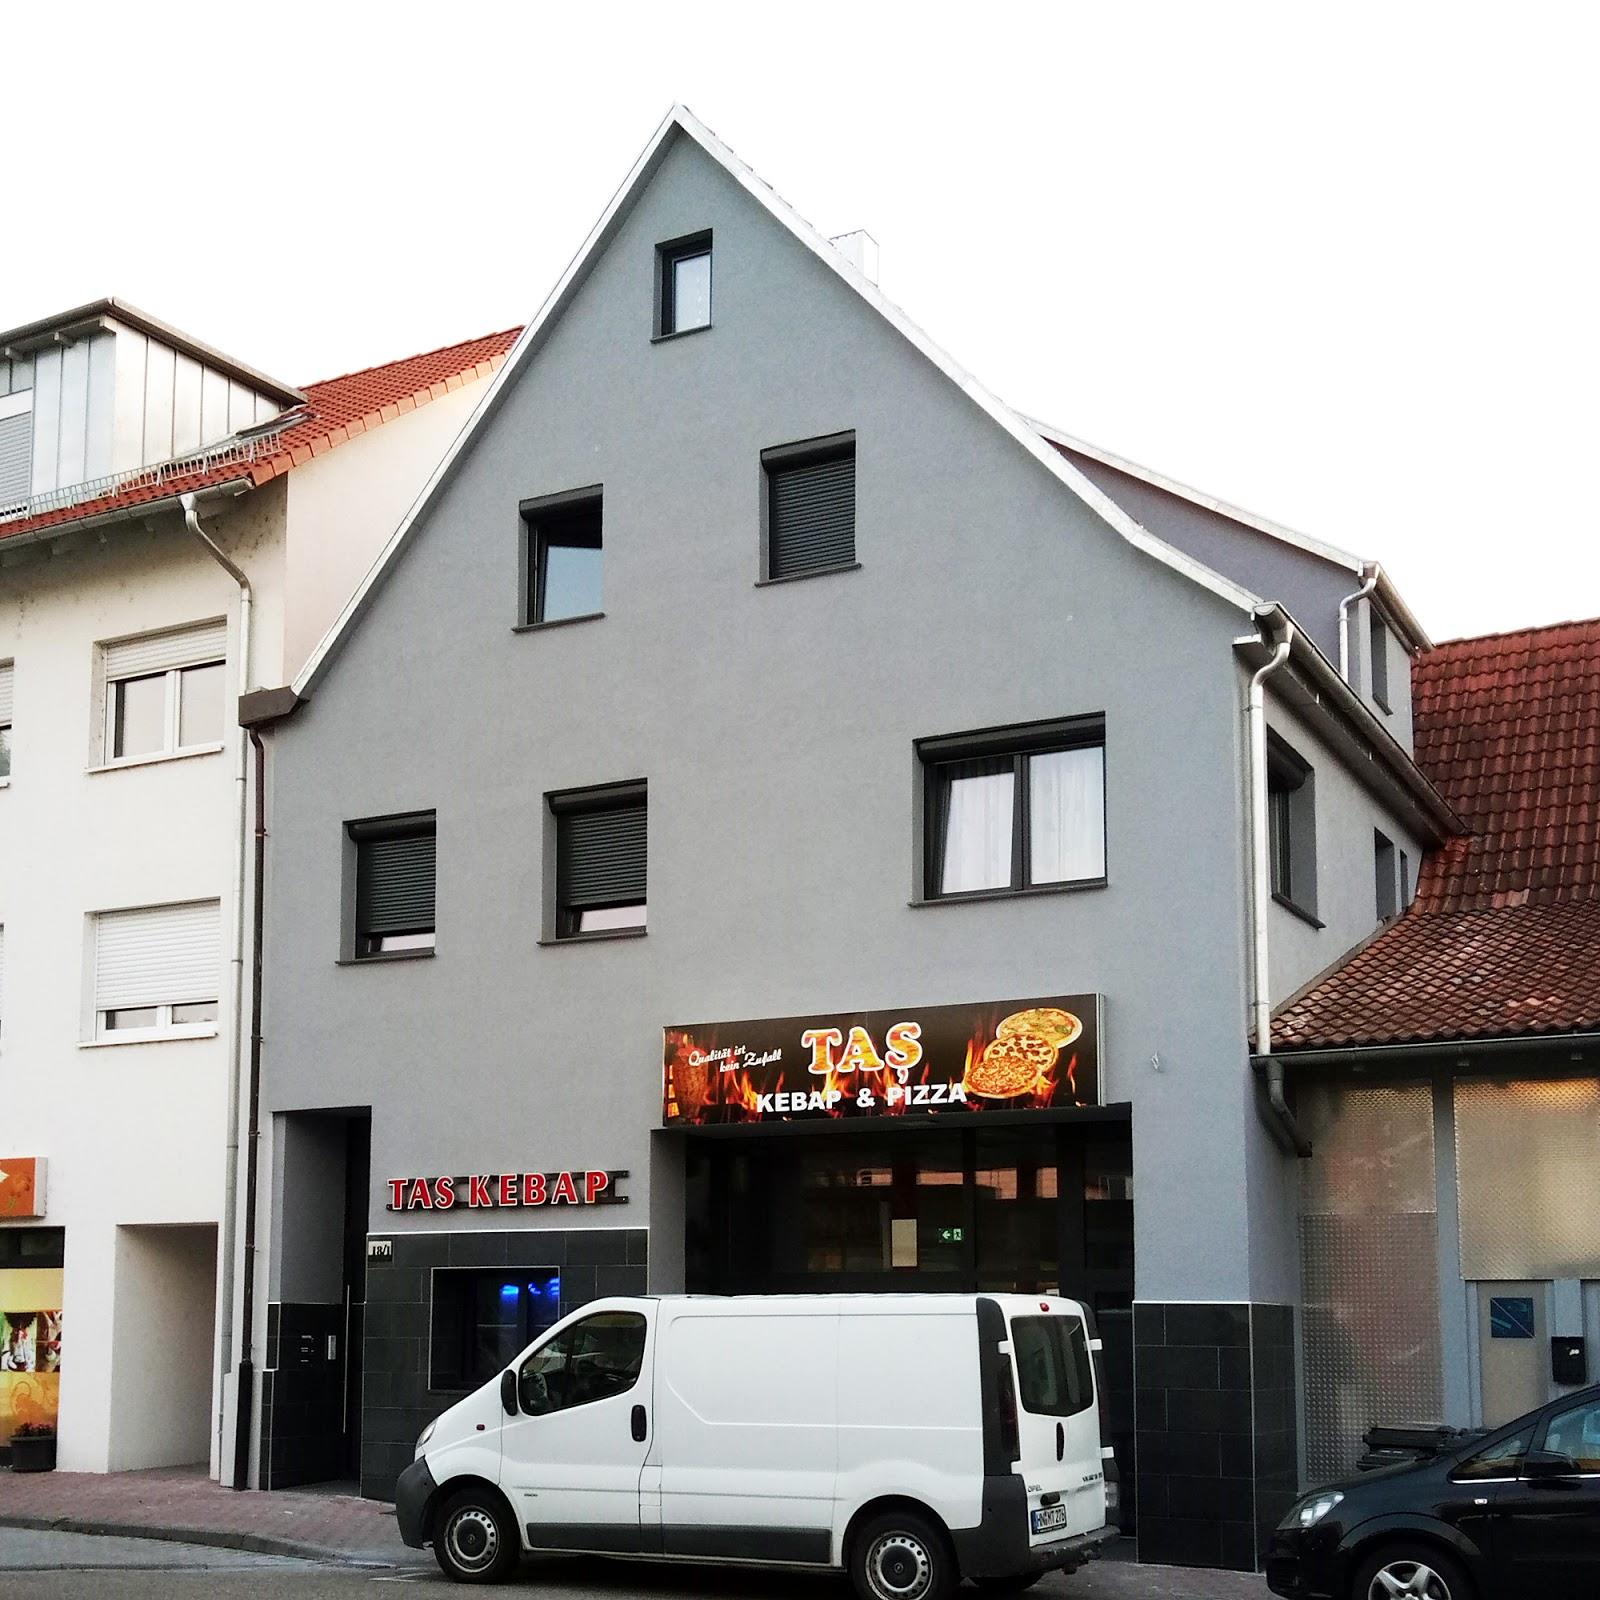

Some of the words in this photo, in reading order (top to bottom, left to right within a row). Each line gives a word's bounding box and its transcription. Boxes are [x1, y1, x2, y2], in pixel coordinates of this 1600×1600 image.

[688, 1048, 732, 1066] Qualität
[734, 1045, 747, 1056] ist
[719, 1061, 740, 1073] kein
[742, 1048, 782, 1068] Zufall
[756, 1089, 842, 1114] KEBAP
[856, 1087, 876, 1108] &
[887, 1083, 968, 1107] PIZZA
[387, 1176, 455, 1210] TAS
[468, 1170, 609, 1207] KEBAP
[373, 1244, 390, 1257] 18/1
